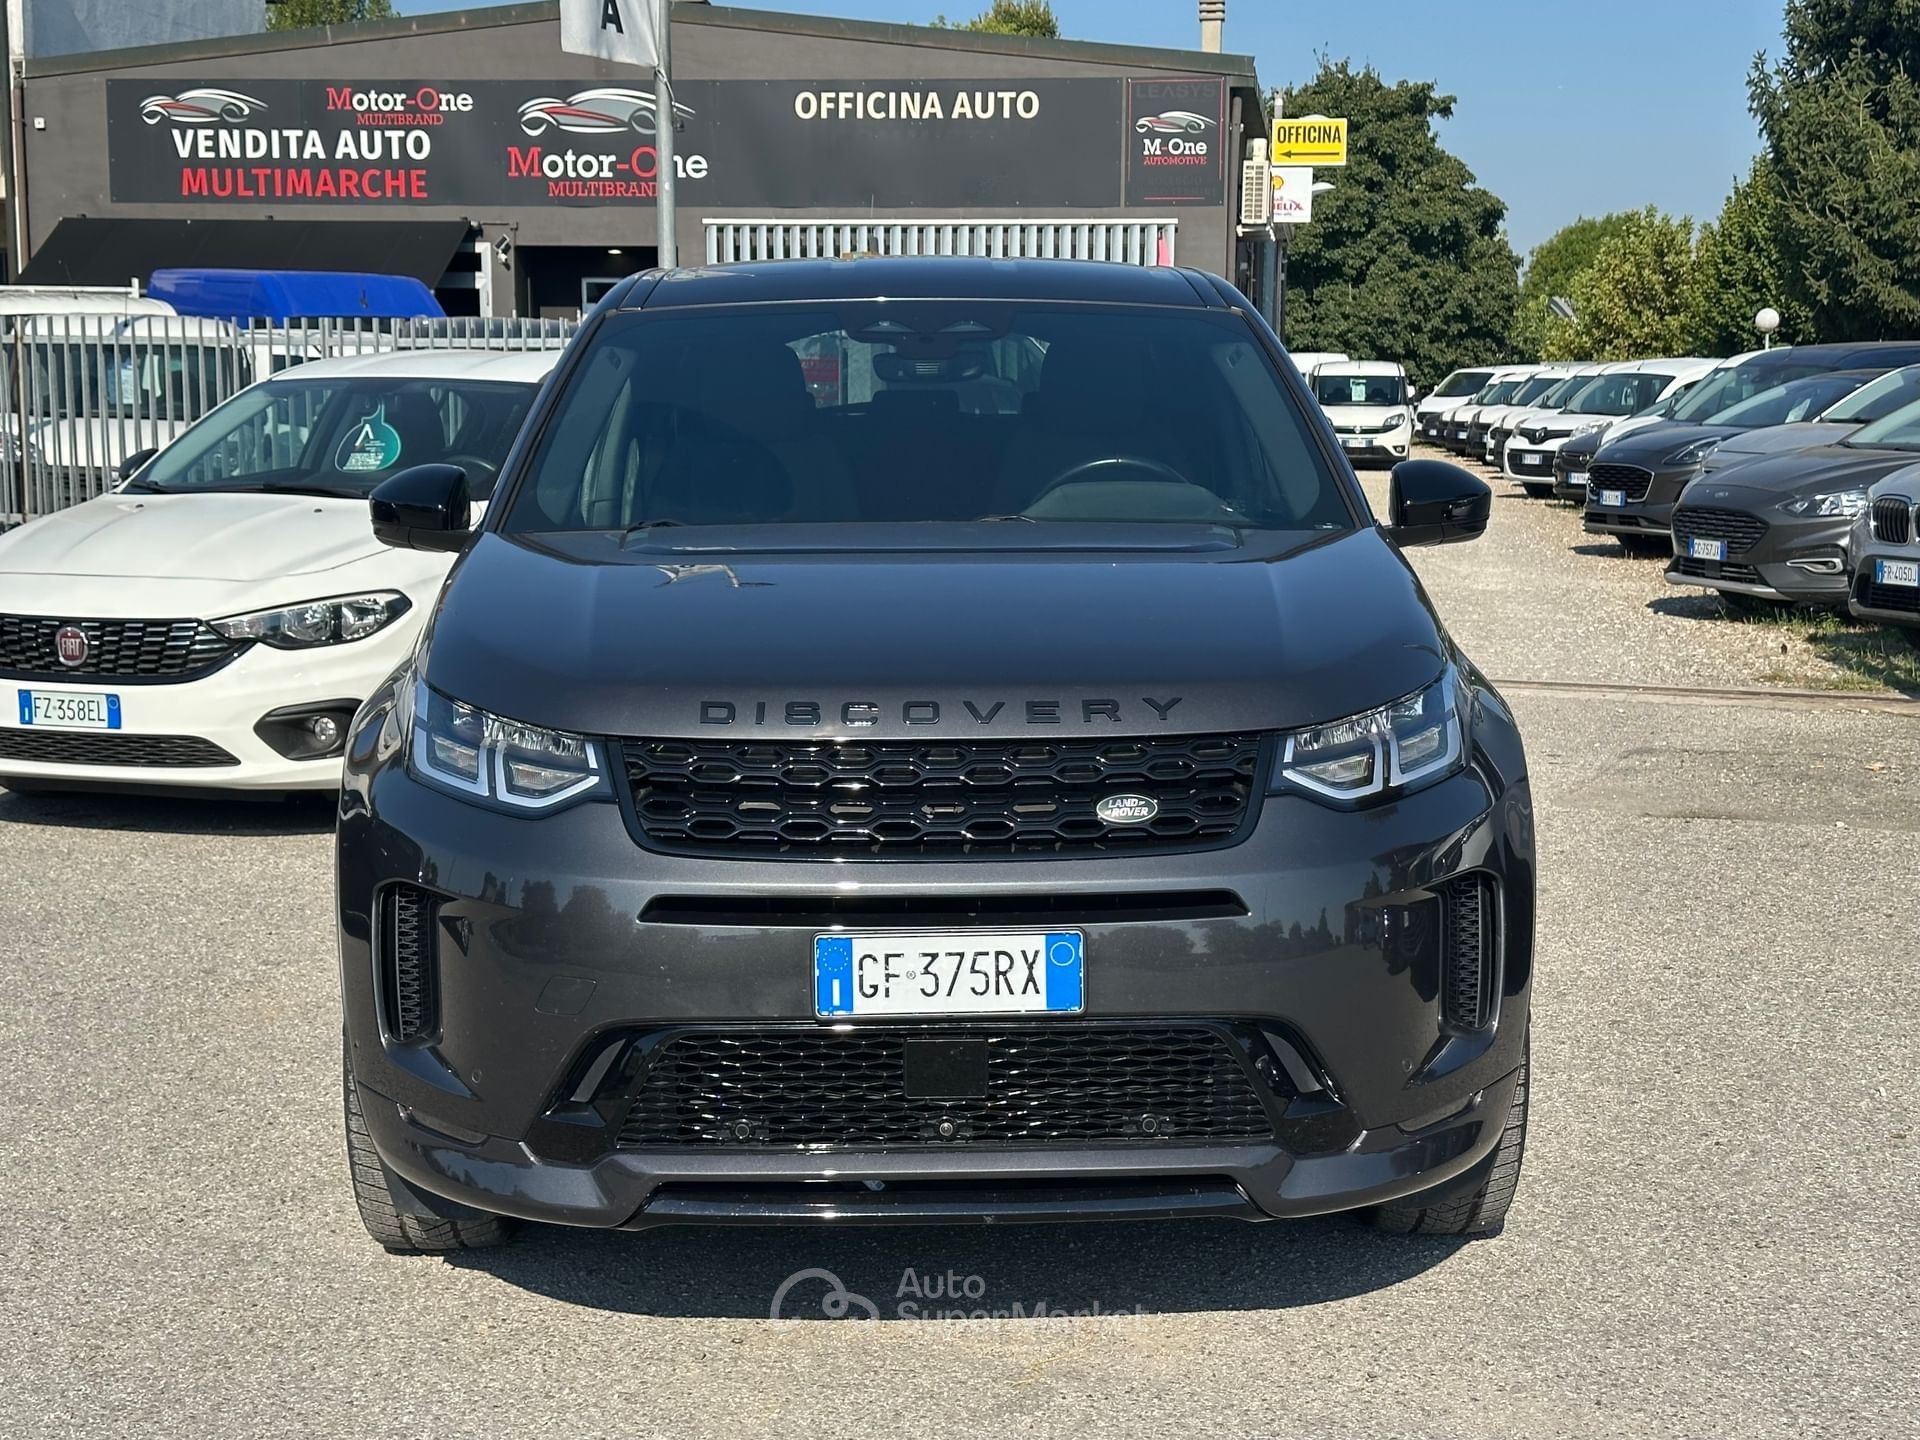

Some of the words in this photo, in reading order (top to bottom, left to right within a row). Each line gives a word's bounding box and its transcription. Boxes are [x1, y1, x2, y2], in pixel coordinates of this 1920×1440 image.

[600, 0, 624, 34] A
[326, 86, 474, 112] Motor-One
[794, 91, 944, 120] OFFICINA
[951, 91, 1040, 120] AUTO
[356, 113, 444, 126] MULTIBRAND
[171, 128, 326, 160] VENDITA
[334, 129, 432, 160] AUTO
[1277, 125, 1342, 144] OFFICINA
[1143, 137, 1208, 156] M-One
[1143, 156, 1208, 166] AUTOMOTIVE
[181, 167, 428, 198] MULTIMARCHE
[548, 181, 657, 198] MULTIBRAN
[61, 637, 81, 656] FIAT
[700, 697, 1183, 726] DISCOVERY
[1108, 798, 1138, 809] LAND
[1111, 807, 1149, 818] ROVER
